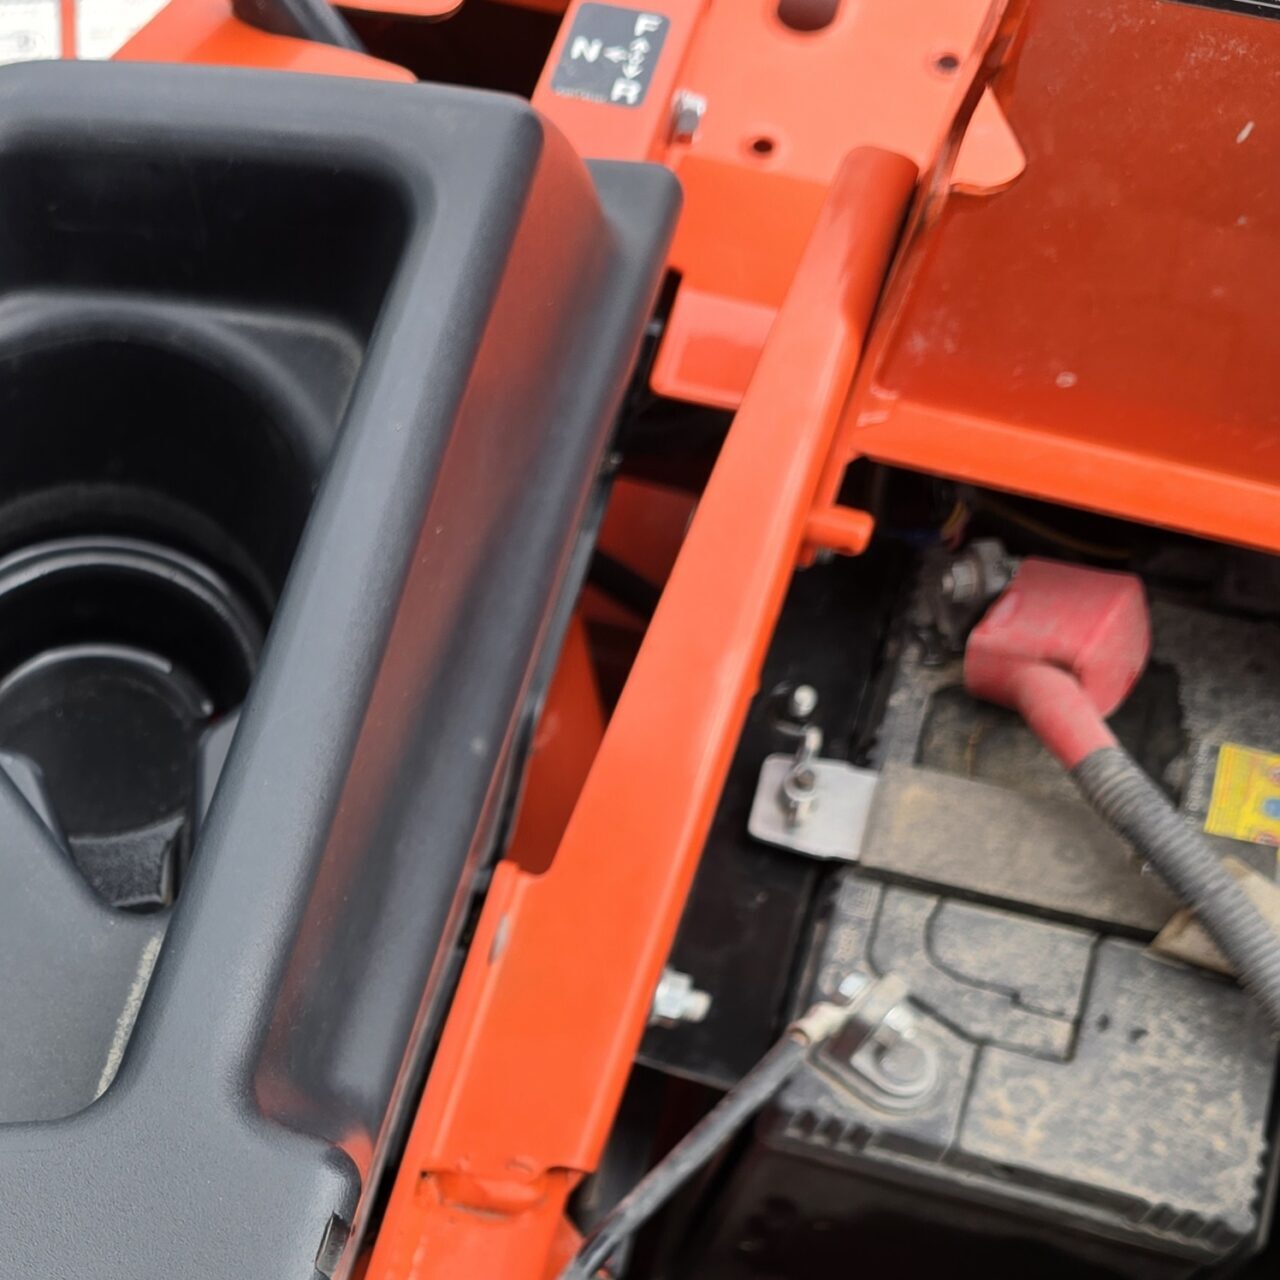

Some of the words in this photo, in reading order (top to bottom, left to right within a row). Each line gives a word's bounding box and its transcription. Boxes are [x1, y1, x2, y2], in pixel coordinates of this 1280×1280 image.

[634, 12, 663, 37] F
[570, 35, 603, 63] N
[610, 77, 642, 105] R
